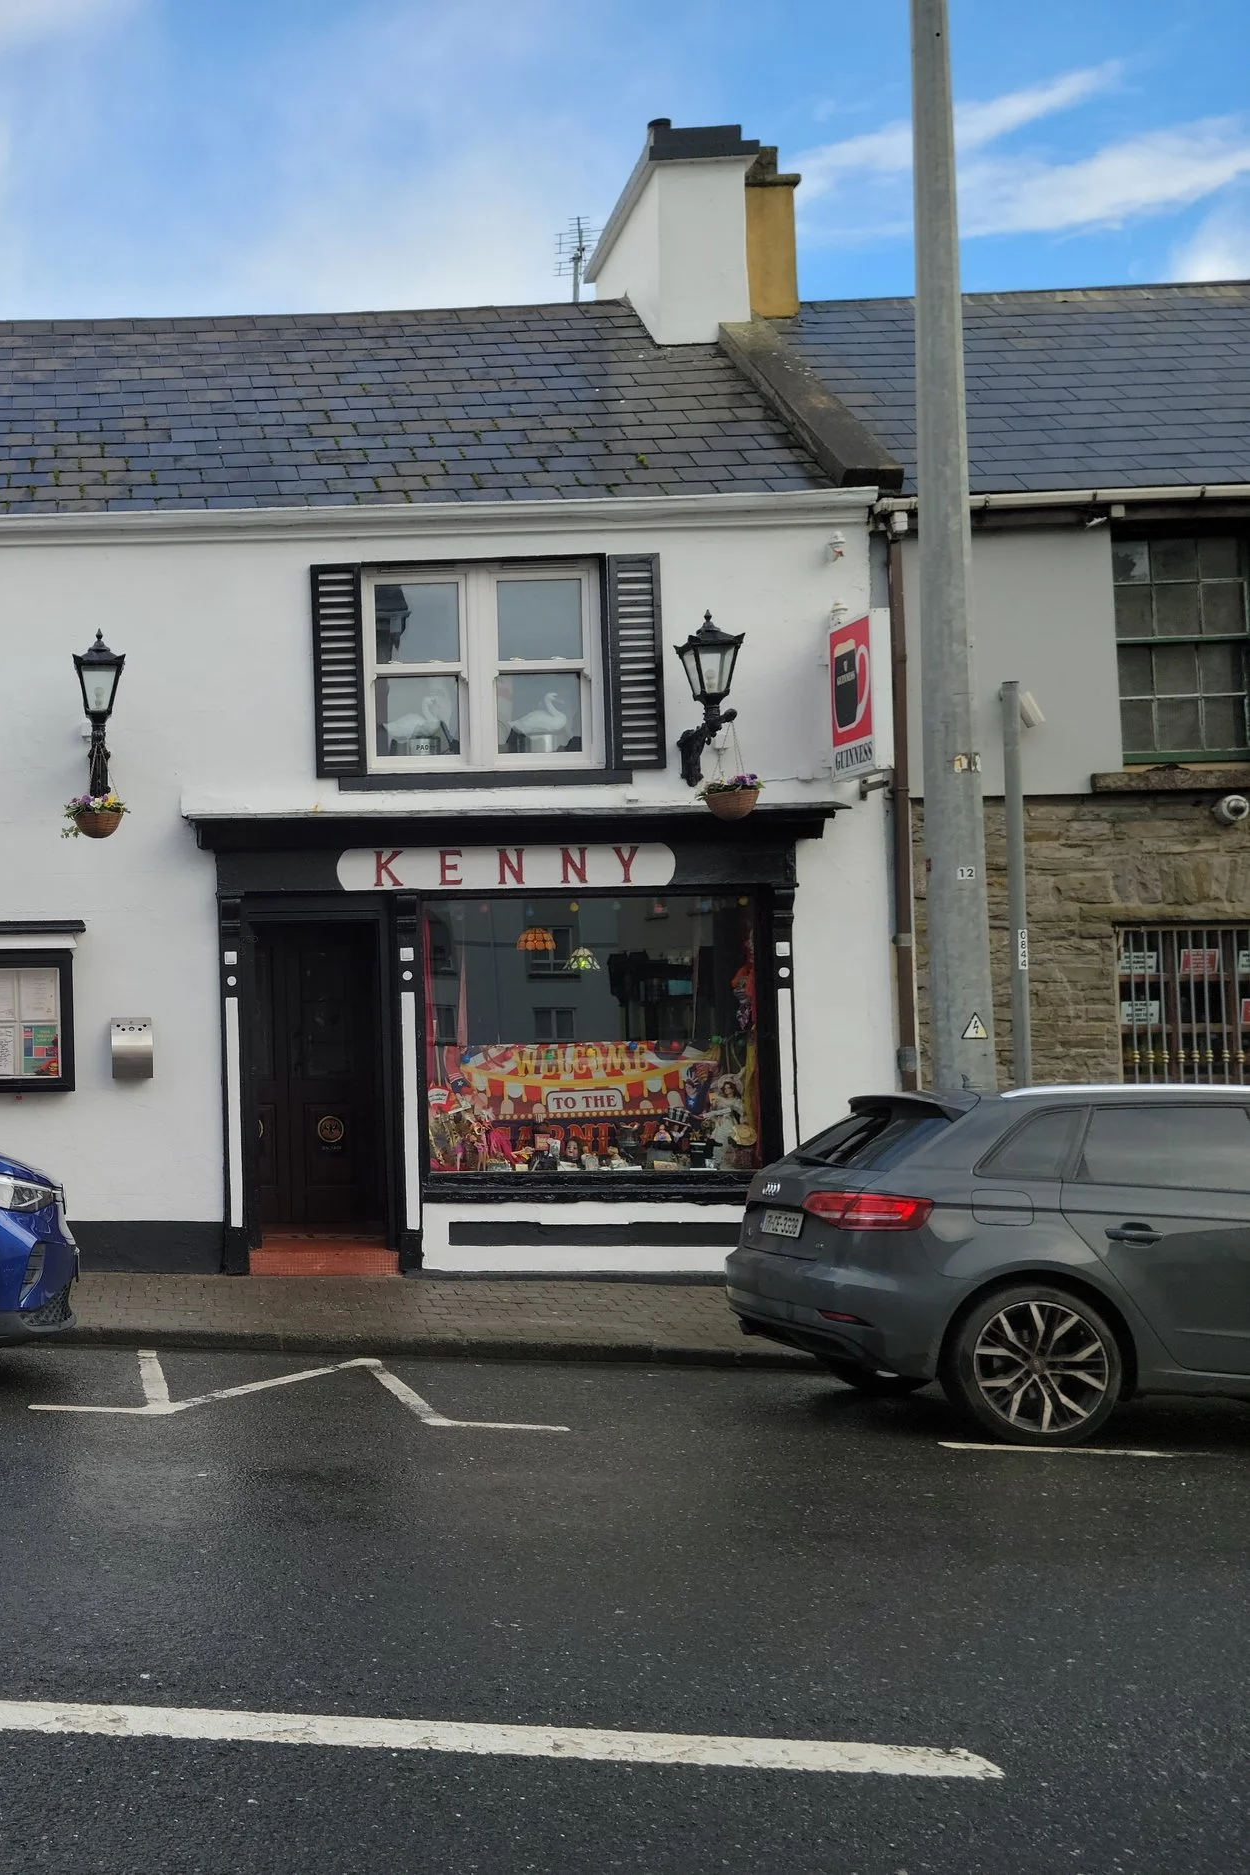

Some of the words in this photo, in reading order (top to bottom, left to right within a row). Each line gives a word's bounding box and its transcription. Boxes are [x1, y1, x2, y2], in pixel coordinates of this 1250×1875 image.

[835, 741, 873, 771] GUINNESS
[373, 845, 640, 887] KENNY
[959, 868, 974, 878] 12
[512, 1043, 649, 1077] WELCOME
[552, 1096, 579, 1110] TO
[582, 1094, 618, 1108] THE
